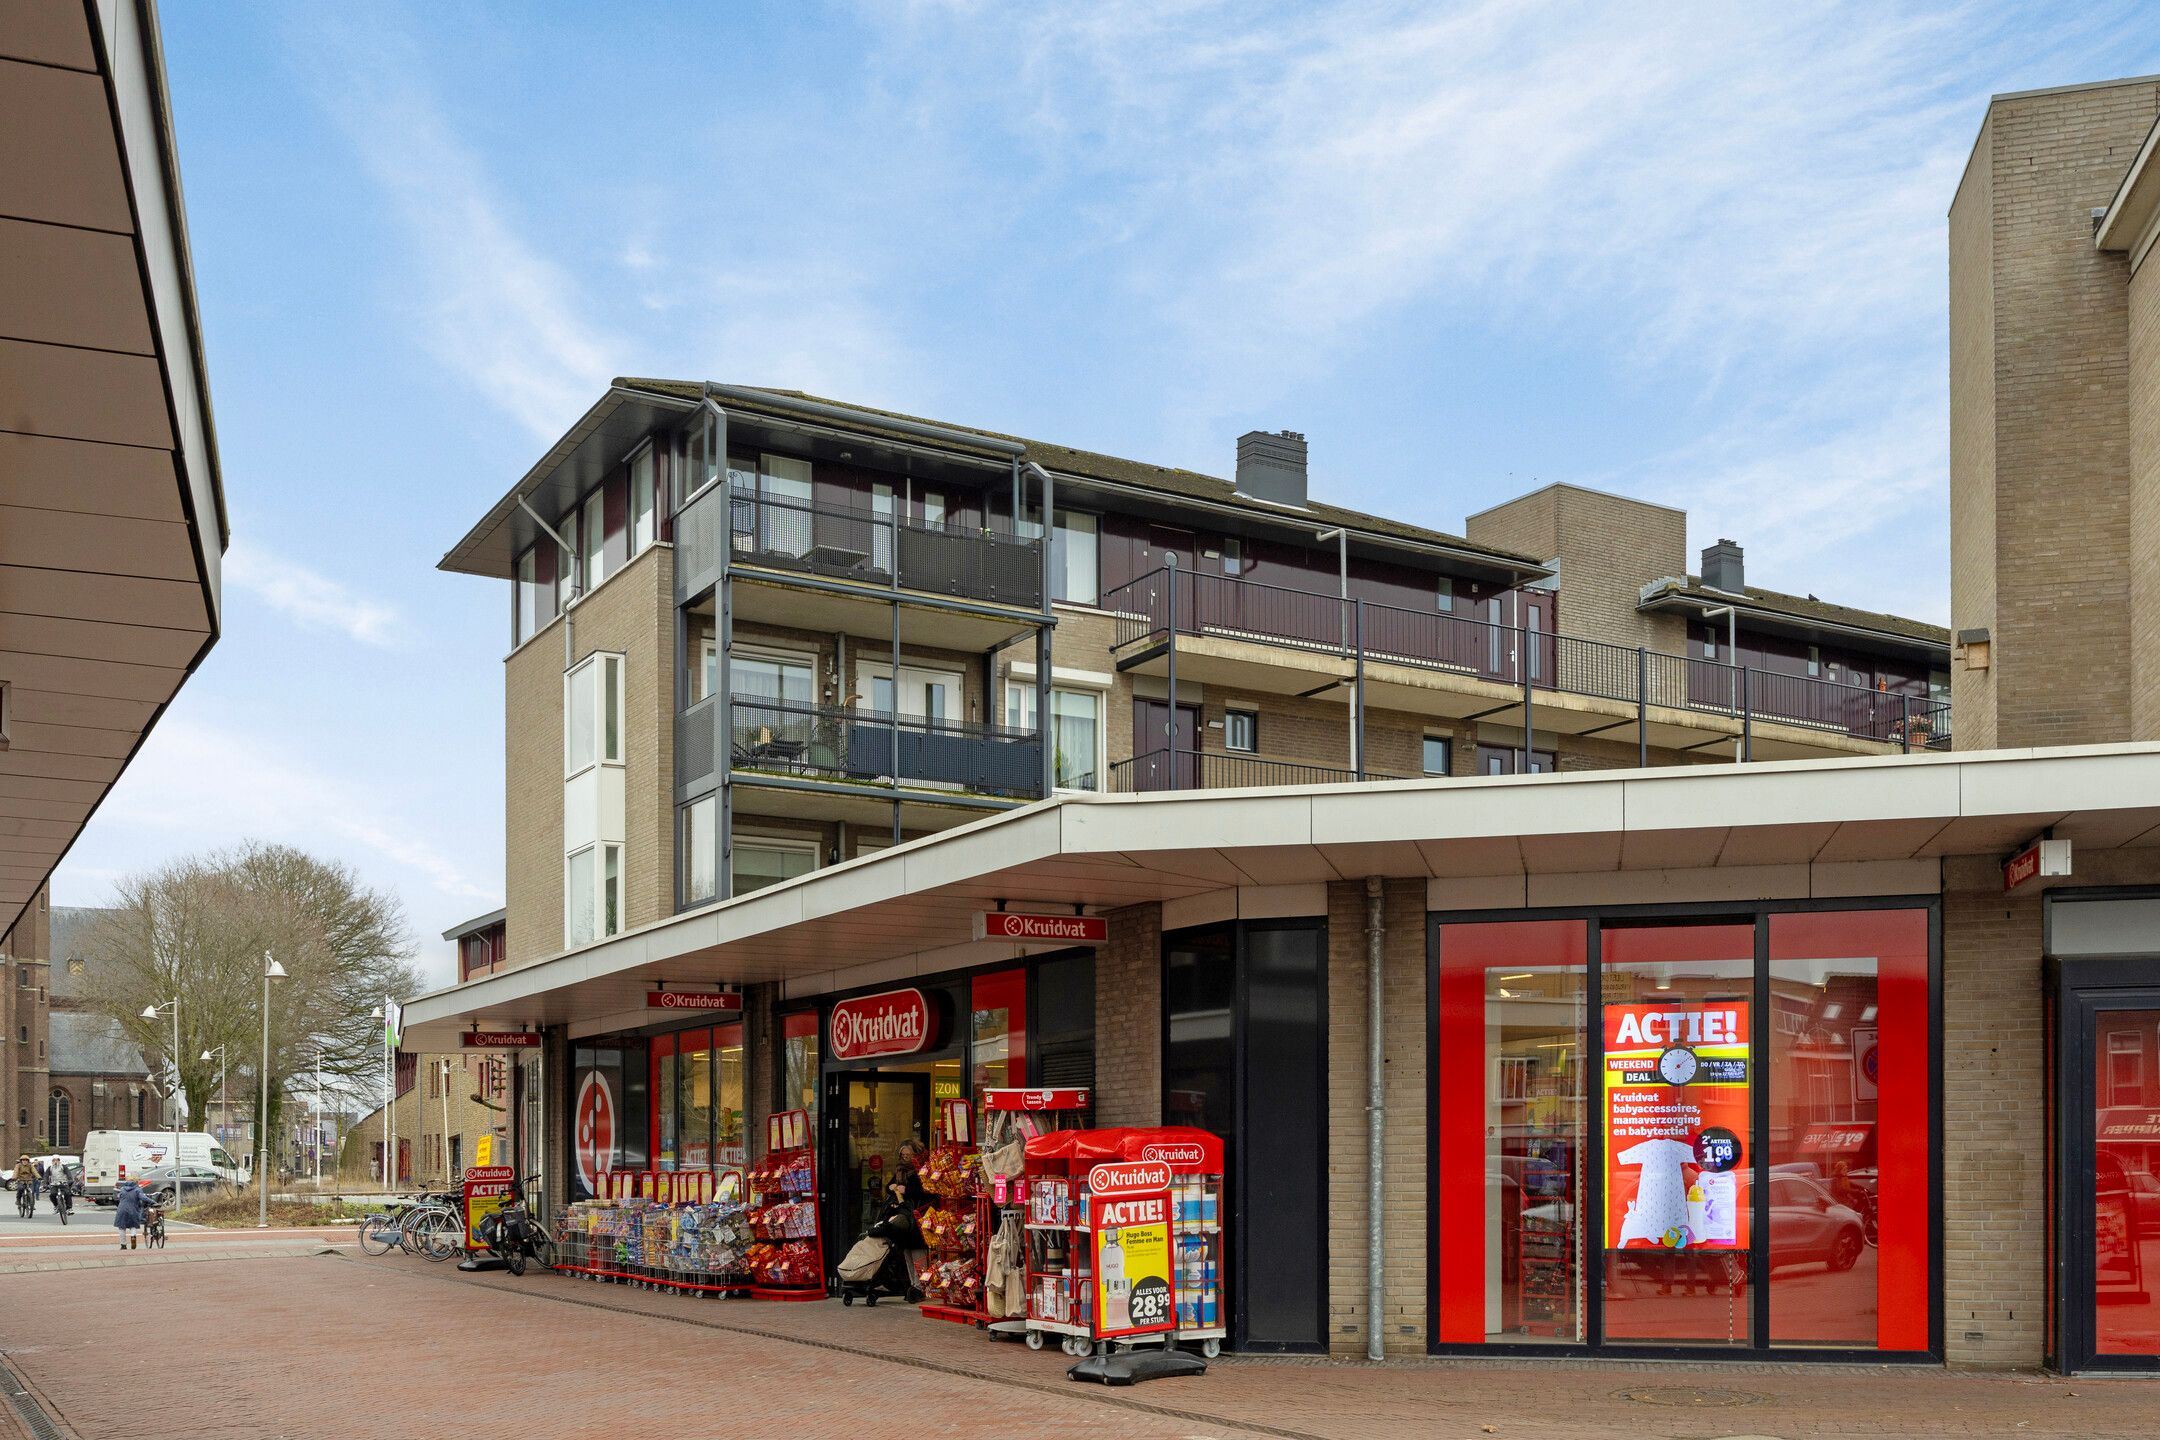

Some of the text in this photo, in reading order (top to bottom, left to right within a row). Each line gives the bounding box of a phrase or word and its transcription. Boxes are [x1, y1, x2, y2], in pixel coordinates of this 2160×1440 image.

[1024, 918, 1086, 937] Kruidvat
[676, 994, 725, 1008] Kruidvat
[852, 1004, 920, 1044] Kruidvat
[1615, 1010, 1738, 1044] ACTIE!
[487, 1035, 527, 1045] Kruidvat
[1609, 1060, 1654, 1069] WEEKEND
[1626, 1072, 1651, 1082] DEAL
[1613, 1093, 1659, 1102] Kruidvat
[1613, 1104, 1701, 1115] babyaccessoires,
[1613, 1115, 1701, 1126] mamaverzorging
[1613, 1126, 1689, 1137] en babytextiel
[1158, 1148, 1199, 1160] Kruidvat
[477, 1168, 511, 1178] Kruidvat
[1110, 1168, 1165, 1187] Kruidvat
[1102, 1199, 1163, 1225] ACTIE!
[1135, 1286, 1167, 1296] ALLES VOOR
[1132, 1293, 1171, 1318] 28.99
[1151, 1316, 1165, 1324] STUK
